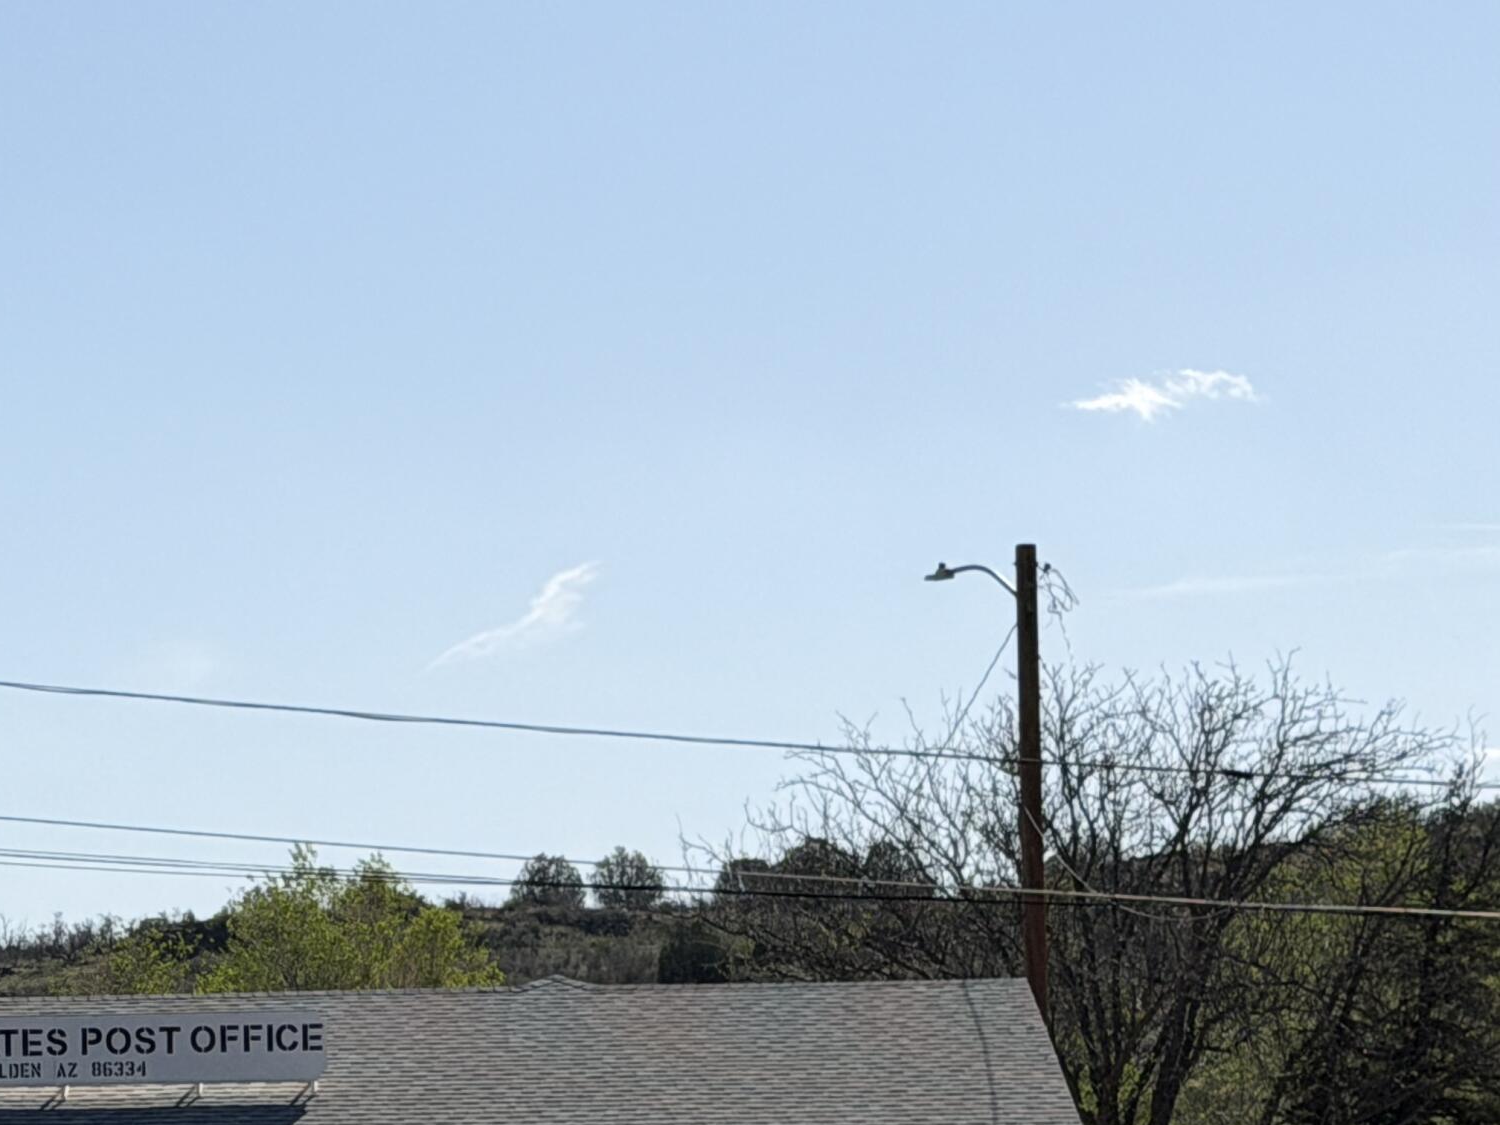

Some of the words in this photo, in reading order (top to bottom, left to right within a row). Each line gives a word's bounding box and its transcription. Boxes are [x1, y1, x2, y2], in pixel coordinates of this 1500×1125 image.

[81, 1026, 181, 1056] POST
[190, 1023, 323, 1053] OFFICE
[56, 1062, 78, 1078] AZ
[91, 1061, 147, 1078] 86334
